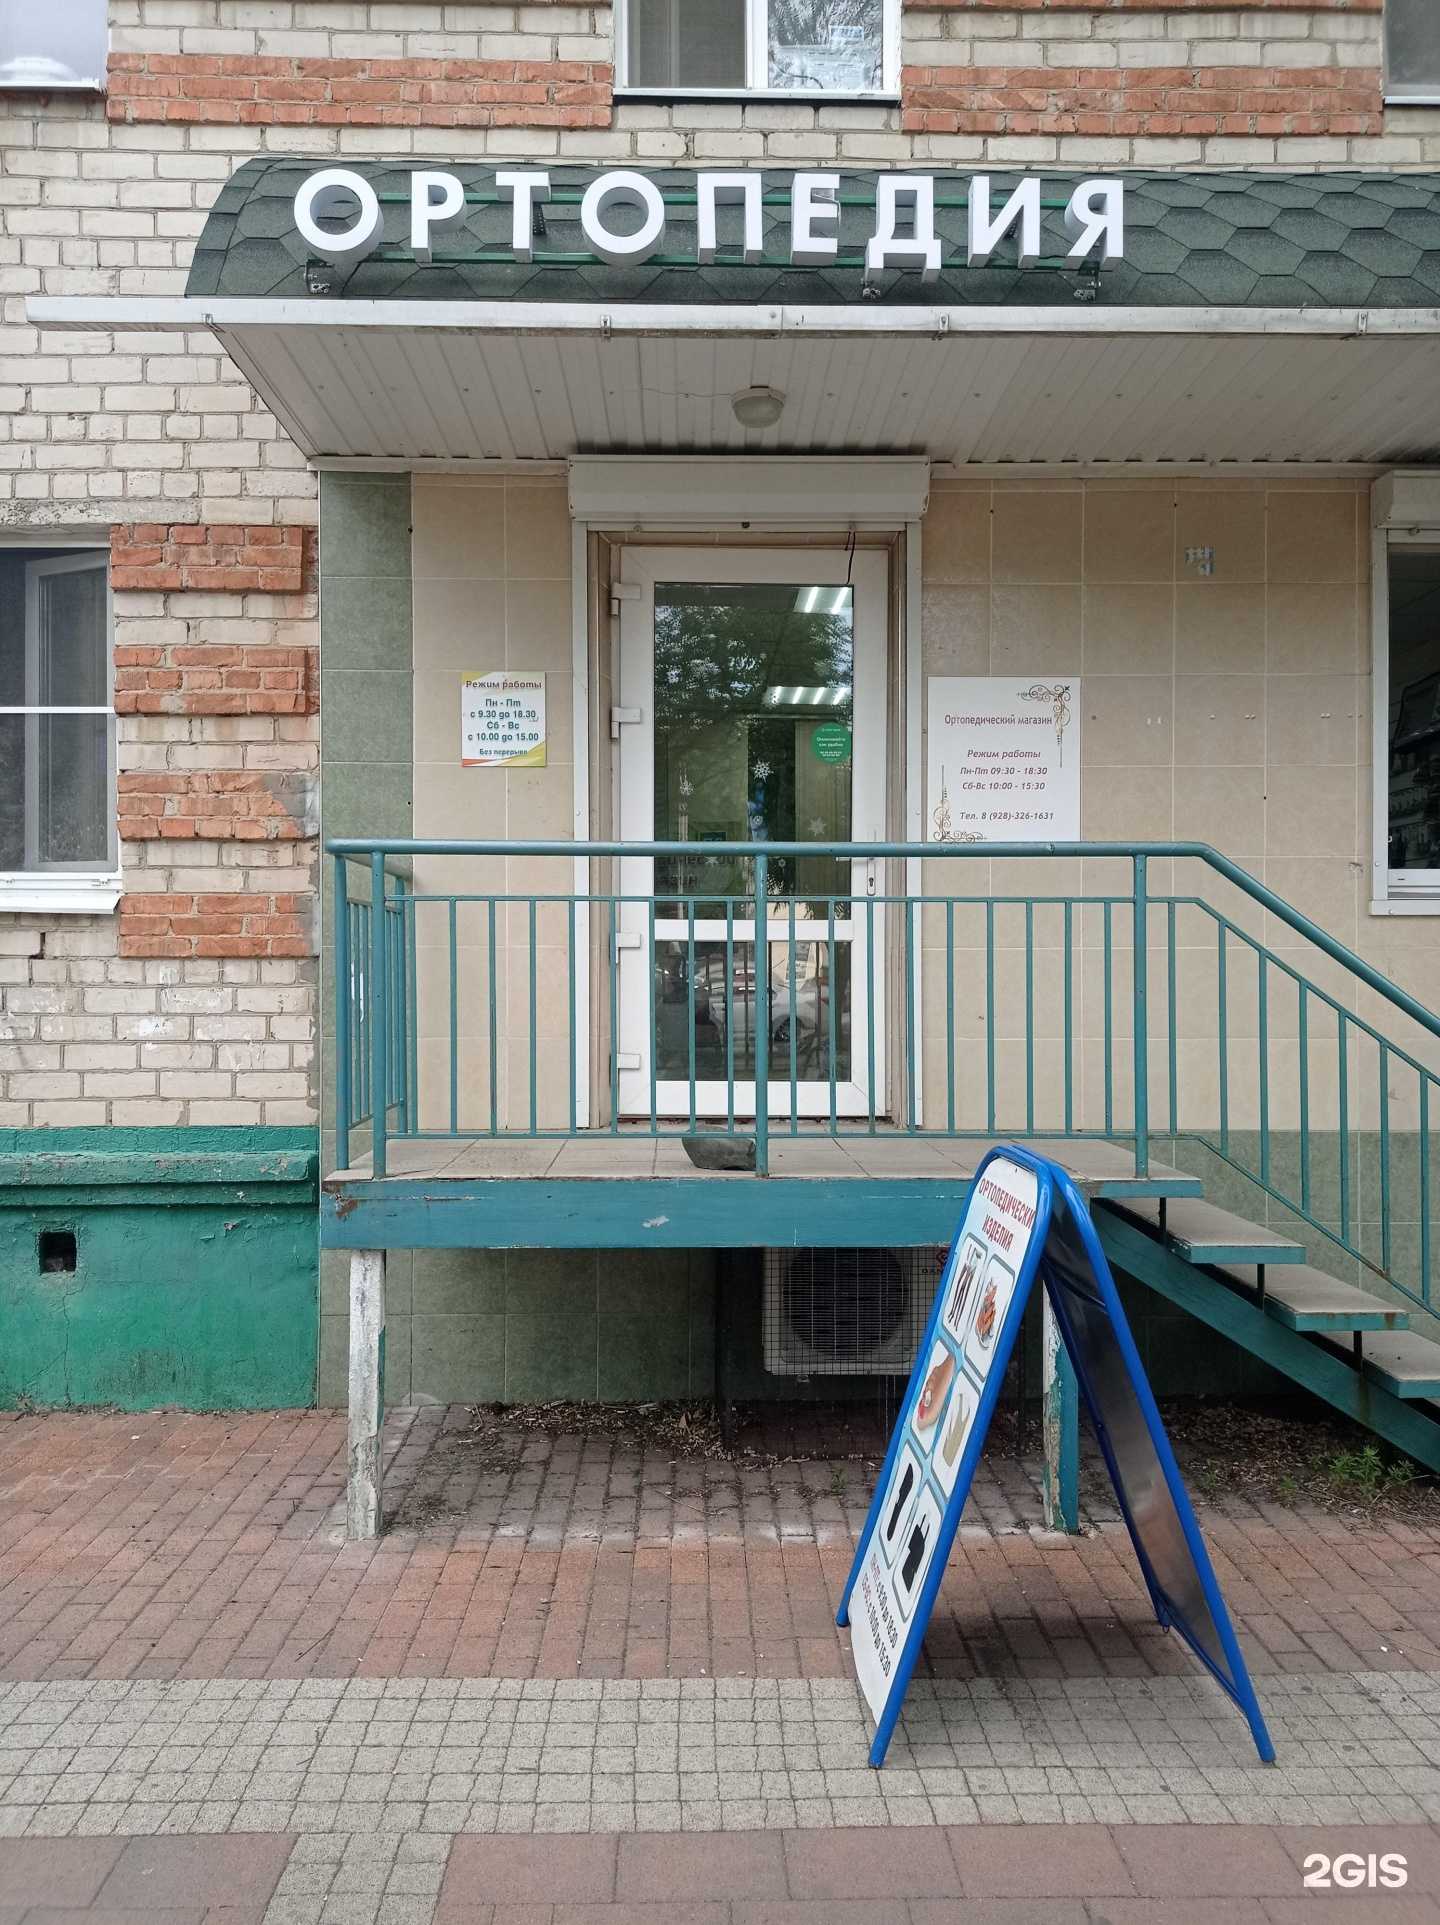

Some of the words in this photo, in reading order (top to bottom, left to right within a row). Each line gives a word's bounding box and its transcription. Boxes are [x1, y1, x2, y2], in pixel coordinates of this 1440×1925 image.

[293, 169, 1124, 276] ОРТОПЕДИЯ
[465, 680, 500, 688] Режим
[502, 680, 542, 690] работы
[485, 698, 498, 707] Пн
[506, 698, 521, 707] Пт
[478, 710, 497, 718] 9.30
[499, 712, 510, 720] до
[513, 710, 536, 718] 18.30
[944, 714, 1016, 726] Ортопедический
[1017, 717, 1052, 725] магазин
[486, 721, 500, 730] Сб
[508, 721, 520, 730] Вс
[476, 732, 499, 741] 10.00
[516, 732, 539, 741] 15.00
[967, 749, 999, 758] Режим
[1001, 749, 1041, 760] работы
[960, 767, 988, 775] Пн-Пт
[990, 767, 1015, 775] 09:30
[1024, 767, 1048, 775] 18:30
[962, 782, 986, 790] Сб-Вс
[989, 782, 1013, 790] 10:00
[1021, 782, 1045, 790] 15:30
[960, 812, 978, 820] Тел.
[981, 812, 987, 820] 8
[989, 811, 1054, 821] (928)-326-1631
[979, 1178, 1036, 1230] ОРТОПЕДИЧЕСКИ
[982, 1214, 1014, 1253] ИЗДЕЛИЯ
